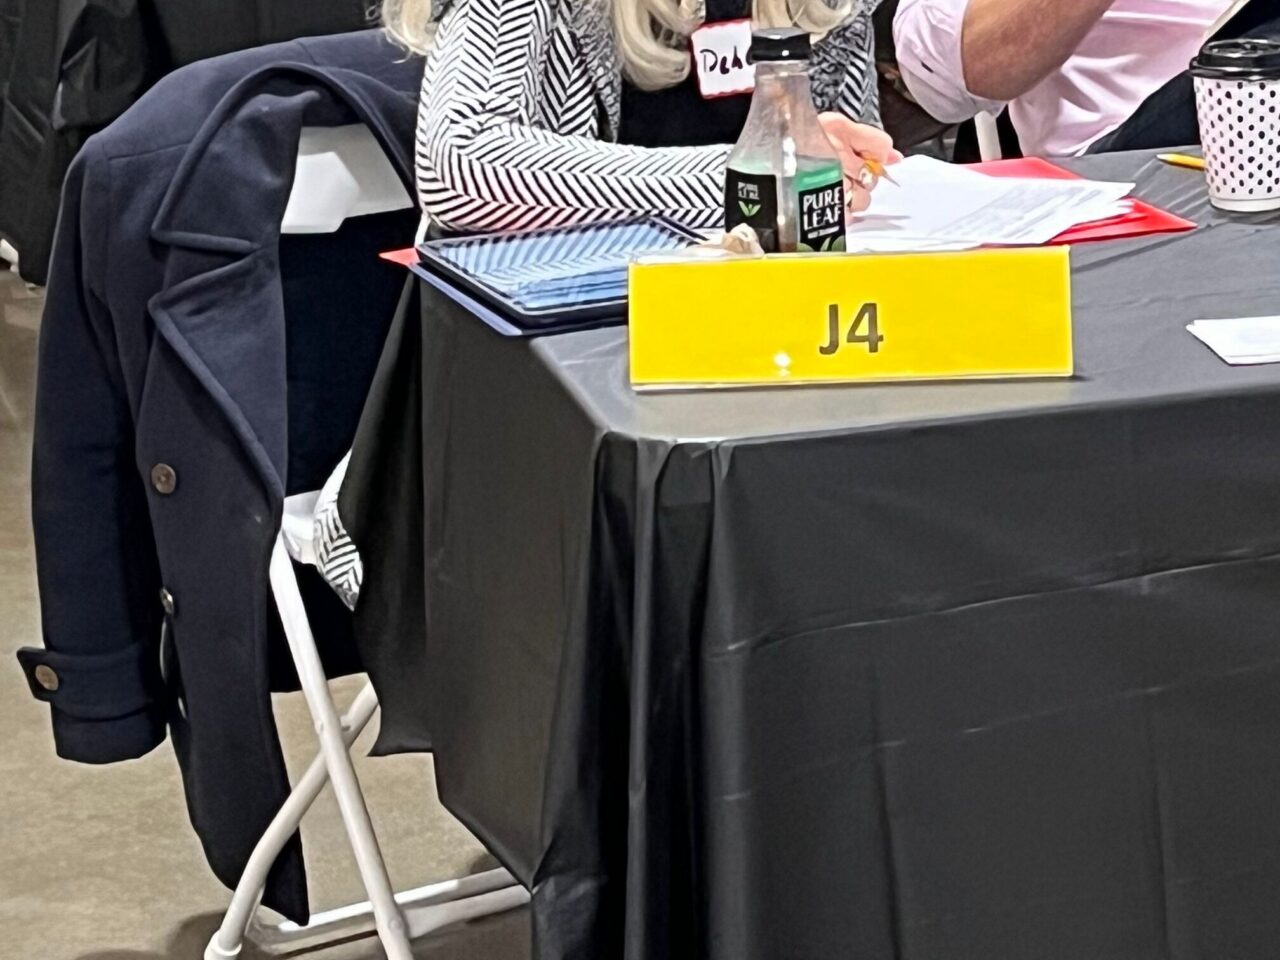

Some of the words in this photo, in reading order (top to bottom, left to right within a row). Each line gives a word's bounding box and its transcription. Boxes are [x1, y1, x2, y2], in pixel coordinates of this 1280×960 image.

[803, 186, 843, 213] PURE
[803, 205, 843, 231] LEAF
[819, 302, 884, 355] J4
